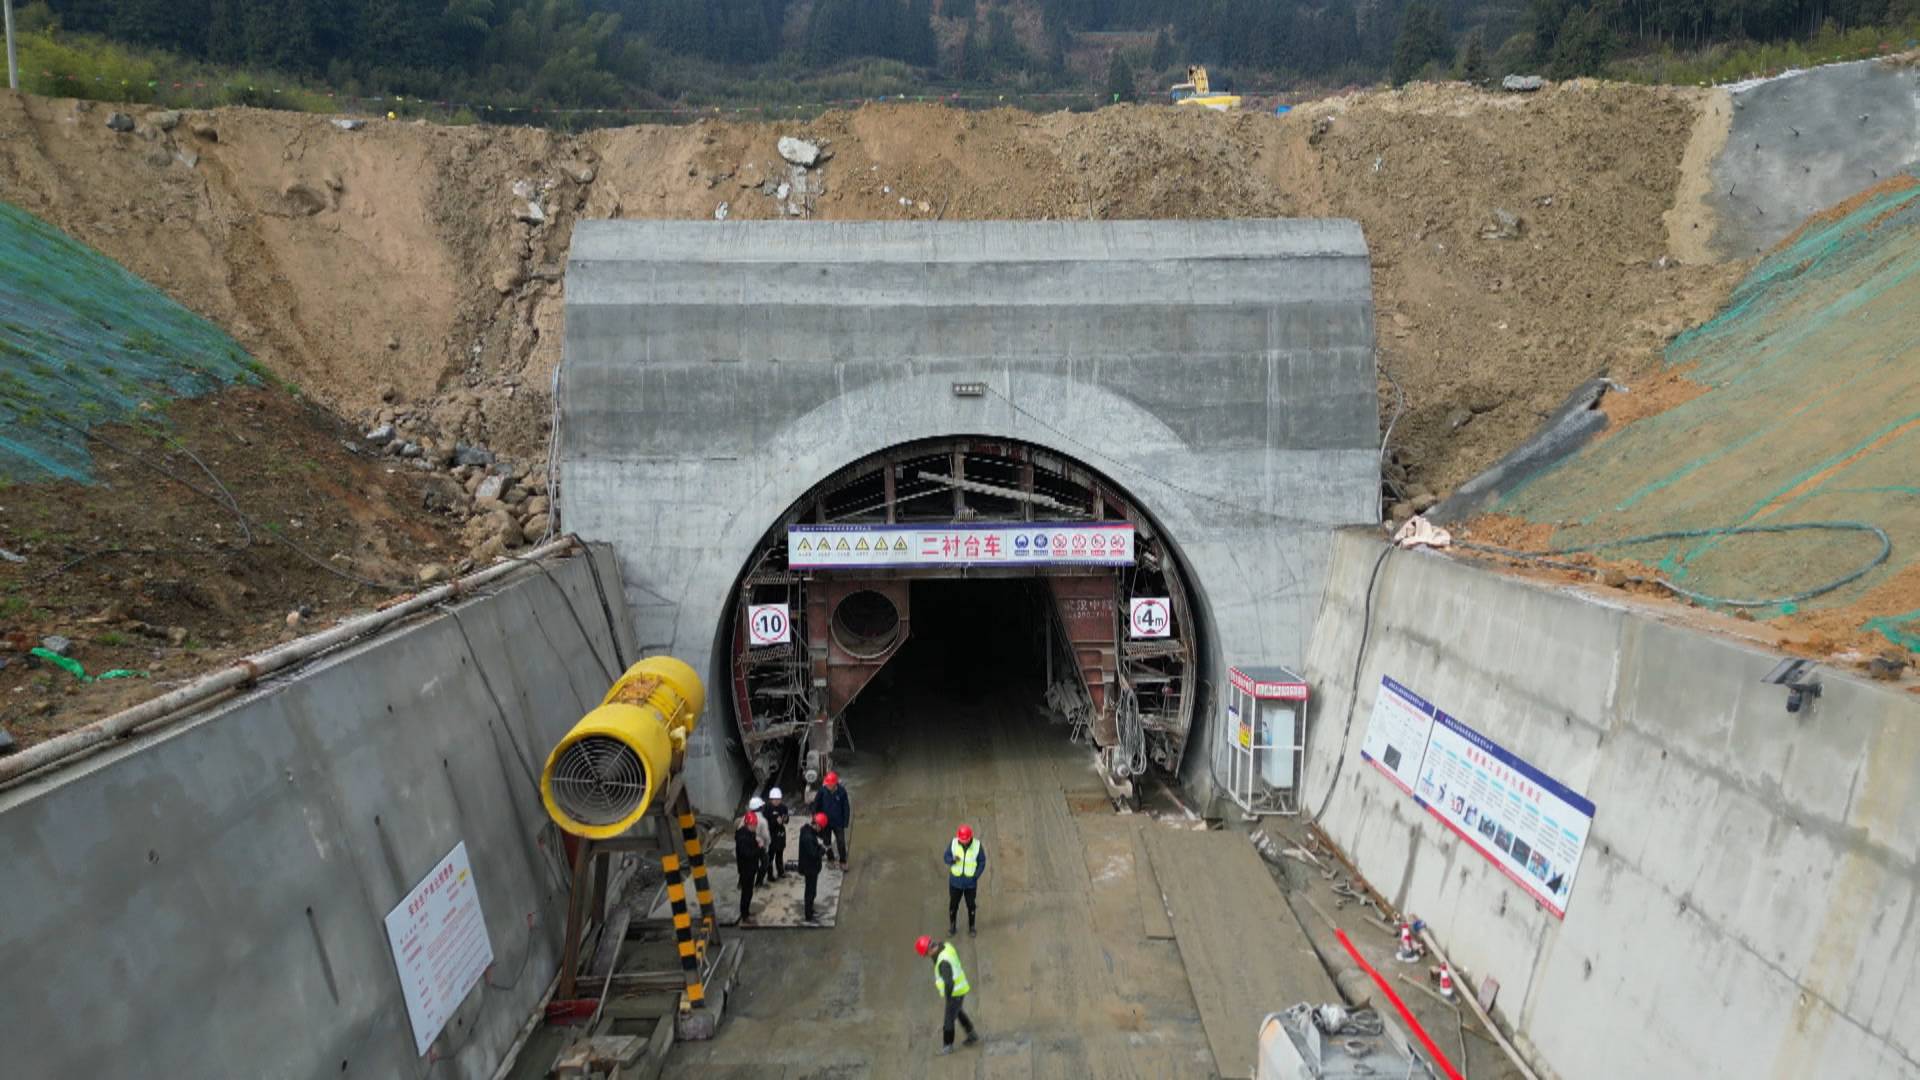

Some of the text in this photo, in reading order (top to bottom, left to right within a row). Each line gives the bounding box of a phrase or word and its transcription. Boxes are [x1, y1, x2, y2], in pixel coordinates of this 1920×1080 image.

[922, 534, 1001, 557] 二衬台车
[760, 614, 782, 633] 10
[1142, 608, 1164, 627] 4m
